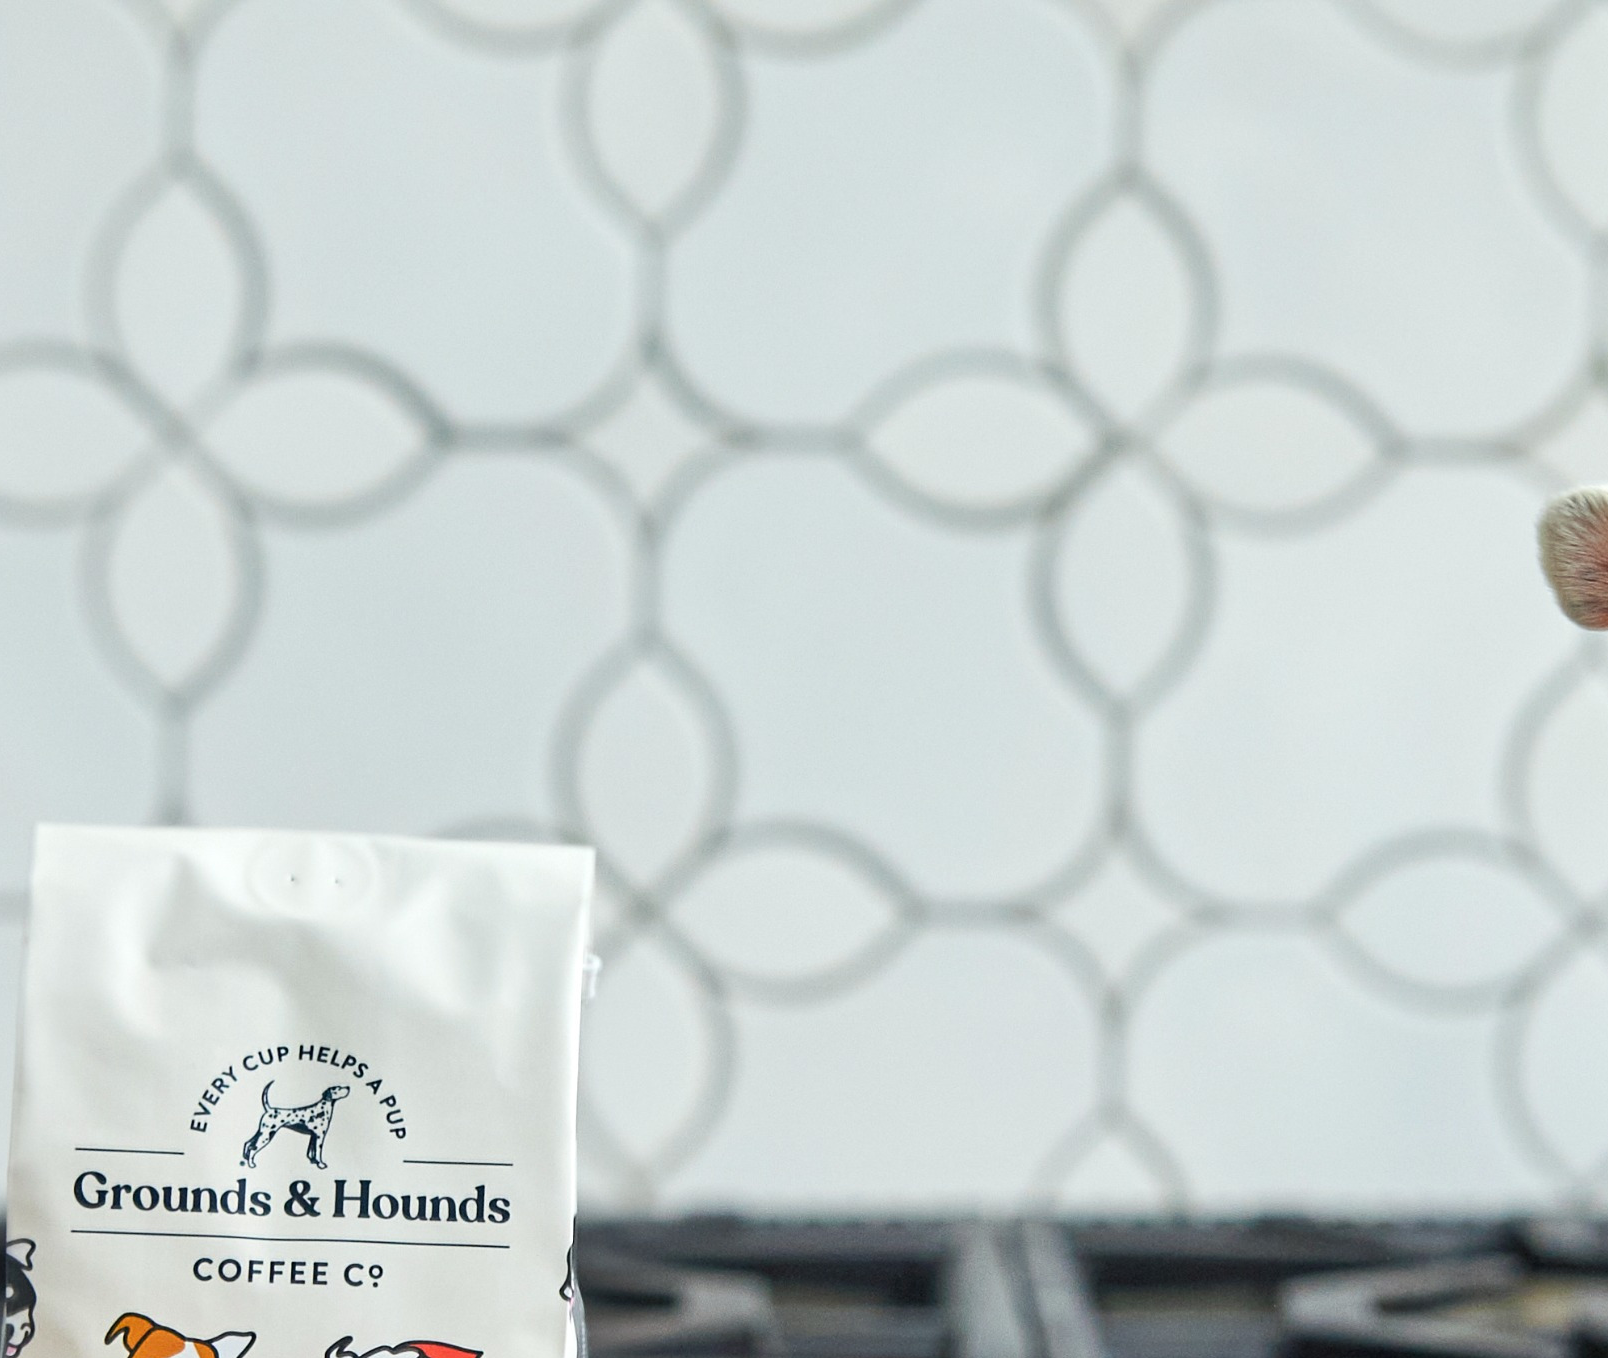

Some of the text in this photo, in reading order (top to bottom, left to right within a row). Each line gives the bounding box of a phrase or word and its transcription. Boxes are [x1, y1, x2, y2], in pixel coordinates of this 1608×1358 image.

[189, 1044, 407, 1140] EVERY CUP HELPS A PUP
[73, 1170, 511, 1224] Grounds & Hounds
[192, 1257, 329, 1286] COFFEE
